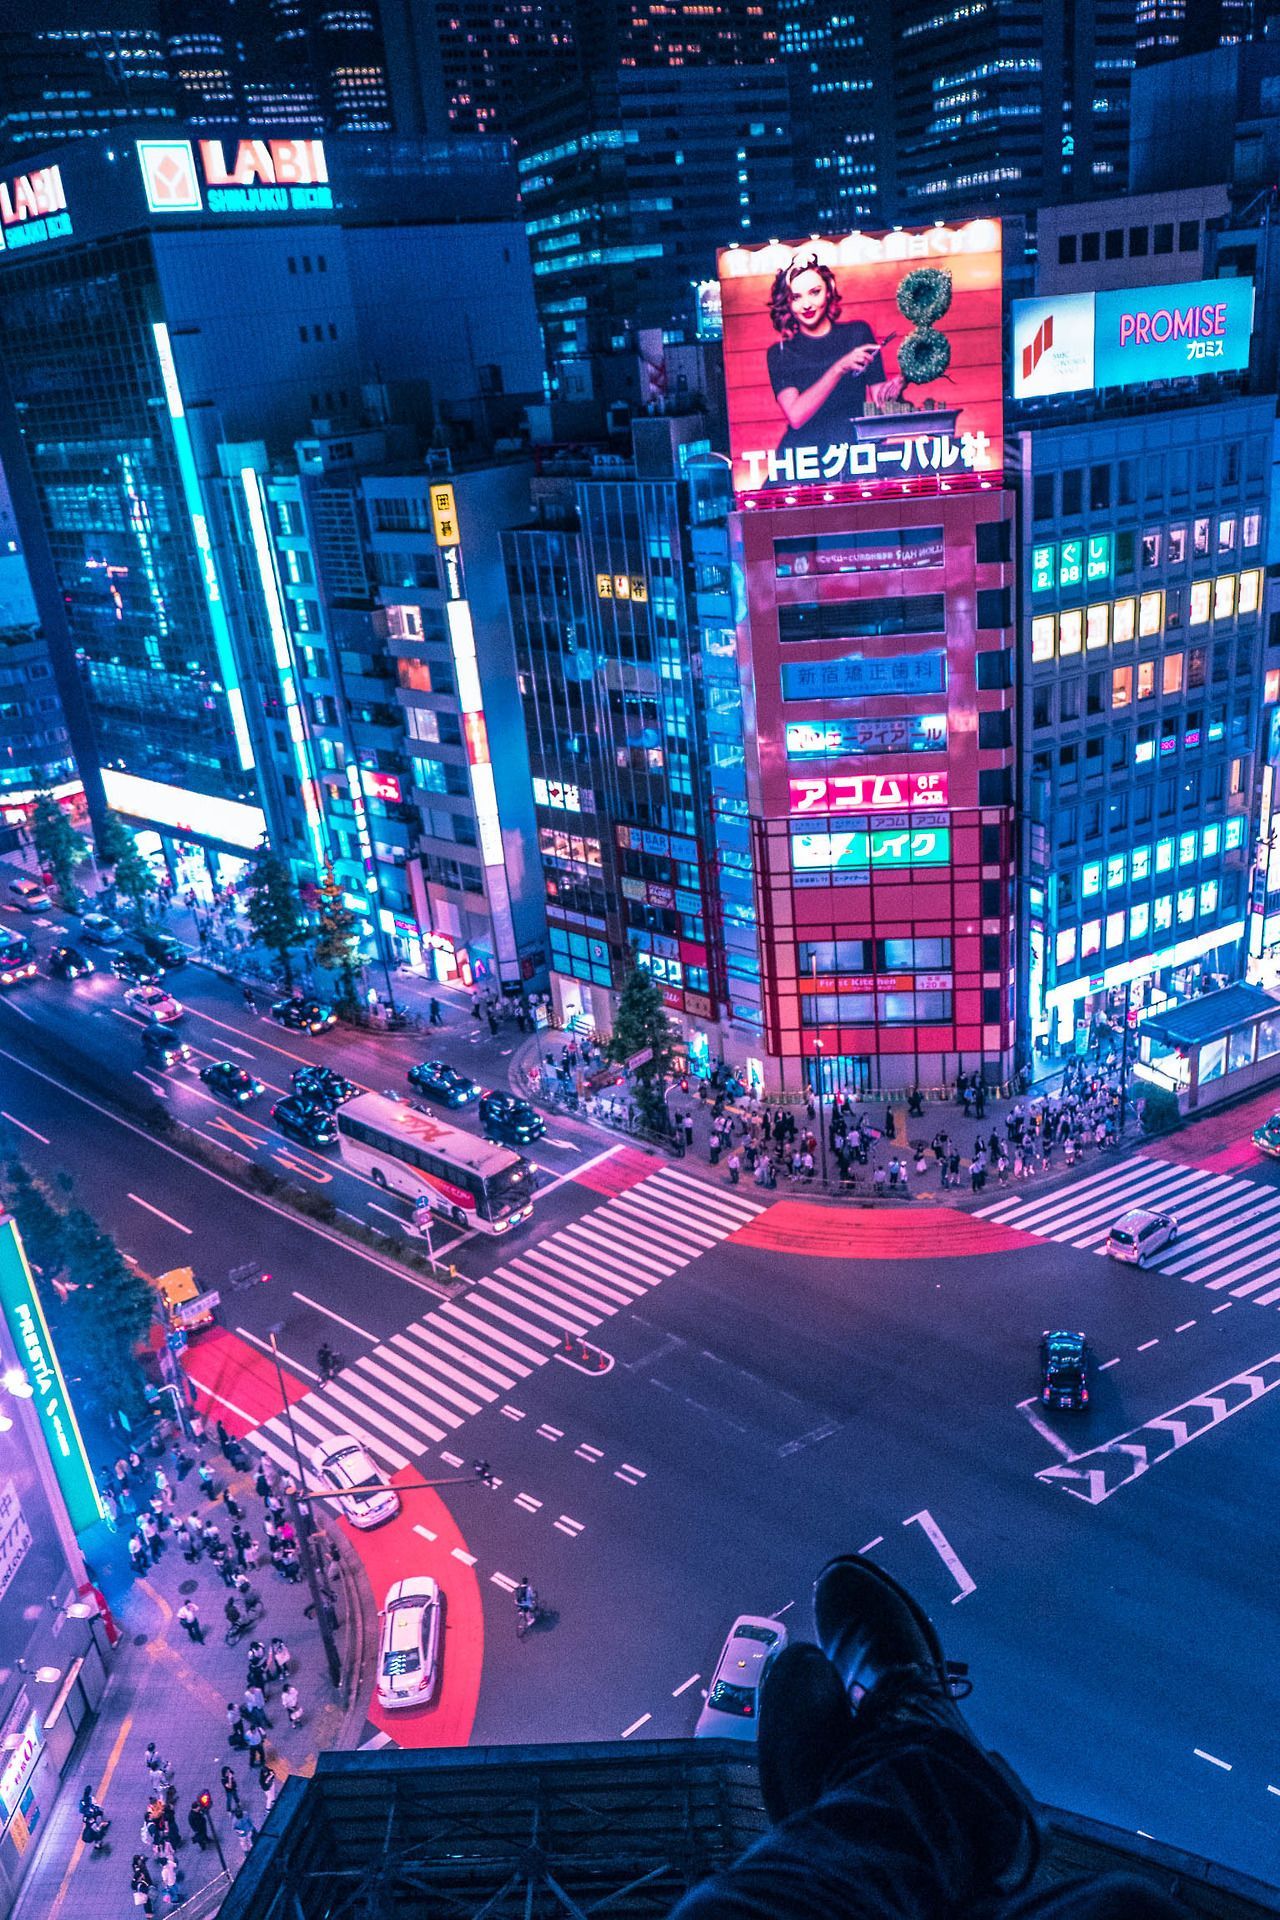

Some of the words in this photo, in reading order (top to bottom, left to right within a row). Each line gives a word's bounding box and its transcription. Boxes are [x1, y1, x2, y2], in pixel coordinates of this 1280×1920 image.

[198, 139, 329, 186] LABI
[0, 164, 67, 225] LABI
[1119, 303, 1228, 347] PROMISE
[1186, 340, 1224, 361] プロミス
[741, 431, 991, 490] THEグローバル社
[796, 776, 902, 809] アコム
[875, 816, 905, 828] アコム
[916, 814, 947, 826] アコム
[865, 832, 936, 858] レイク
